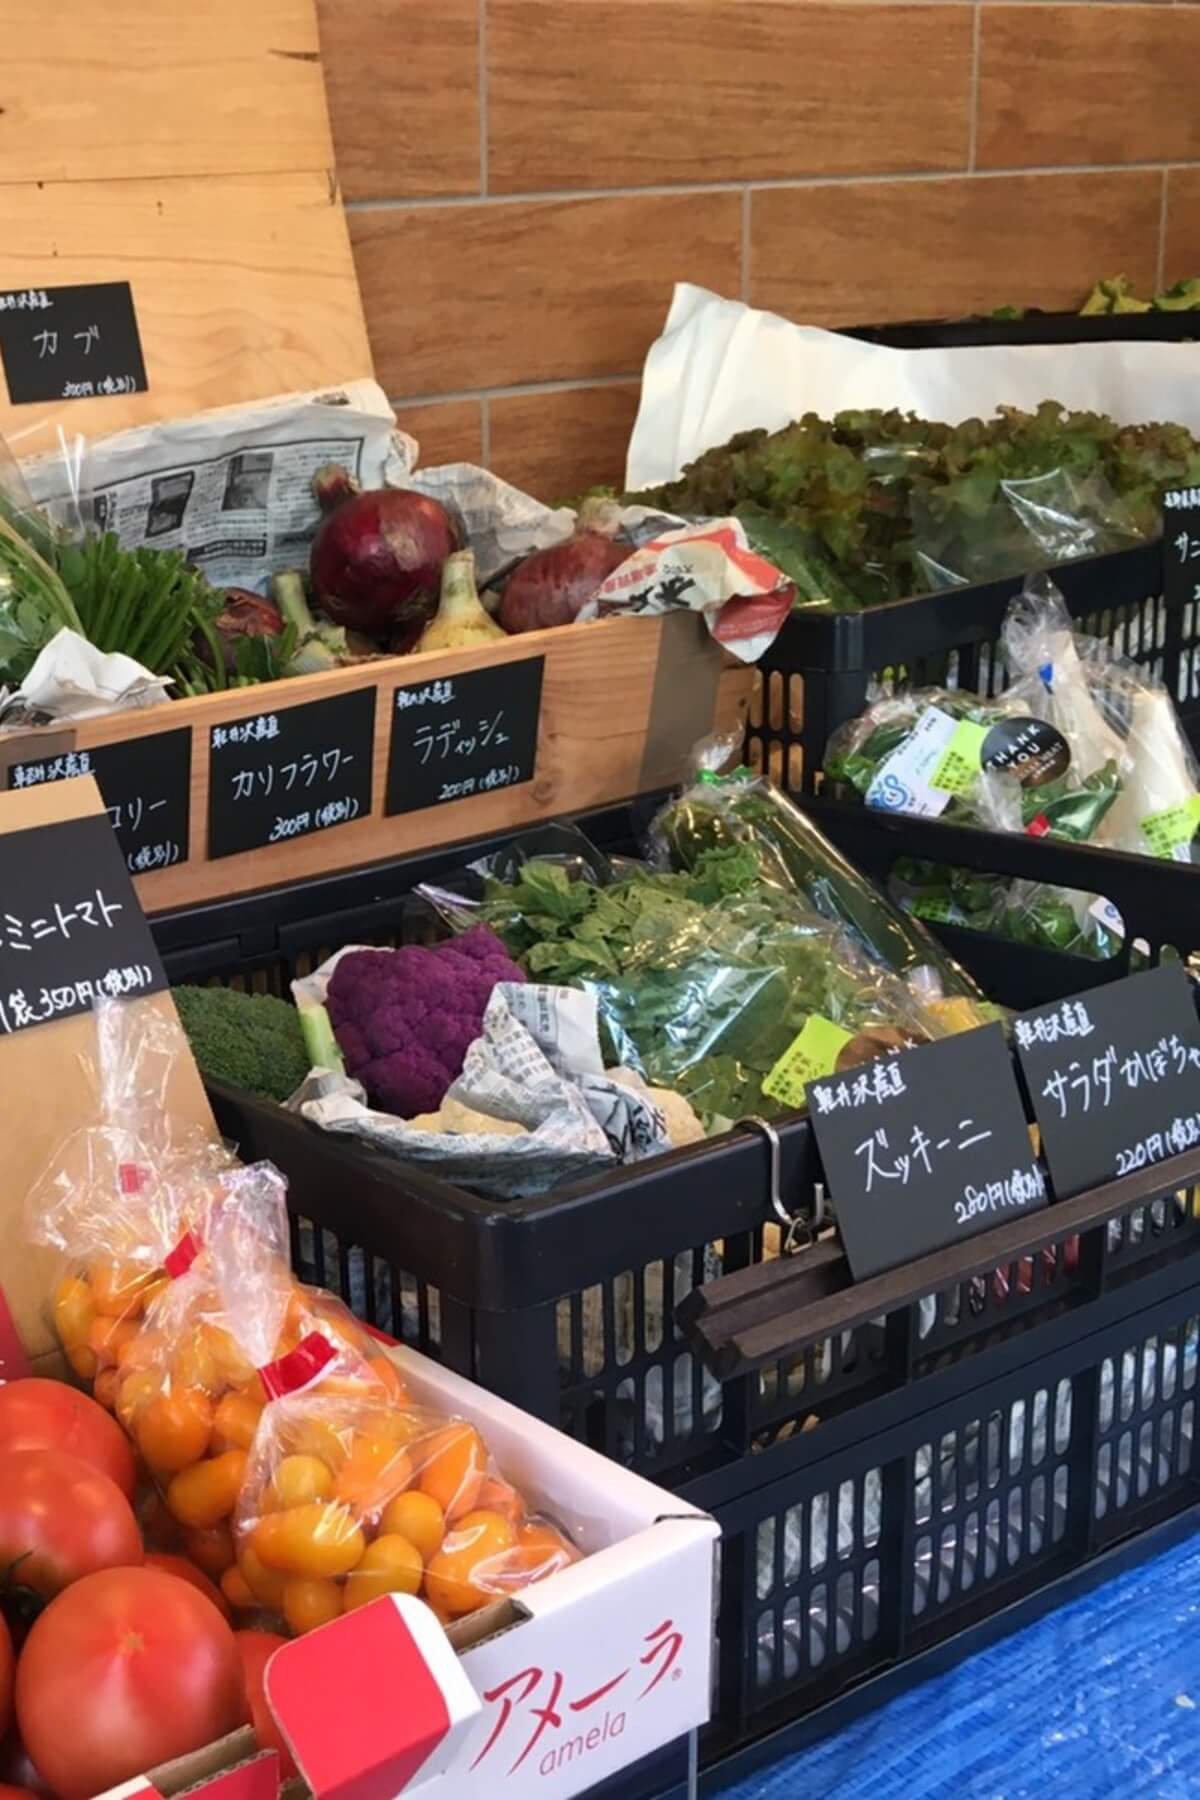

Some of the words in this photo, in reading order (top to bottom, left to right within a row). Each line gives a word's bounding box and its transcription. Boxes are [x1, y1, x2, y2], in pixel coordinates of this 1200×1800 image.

[32, 324, 100, 359] カブ
[412, 710, 510, 765] ラディッシュ
[1006, 742, 1041, 770] YOU
[231, 748, 354, 800] カリフラワー
[855, 1119, 992, 1193] ズッキーニ
[468, 1619, 683, 1777] アメーラ
[538, 1710, 627, 1776] amela
